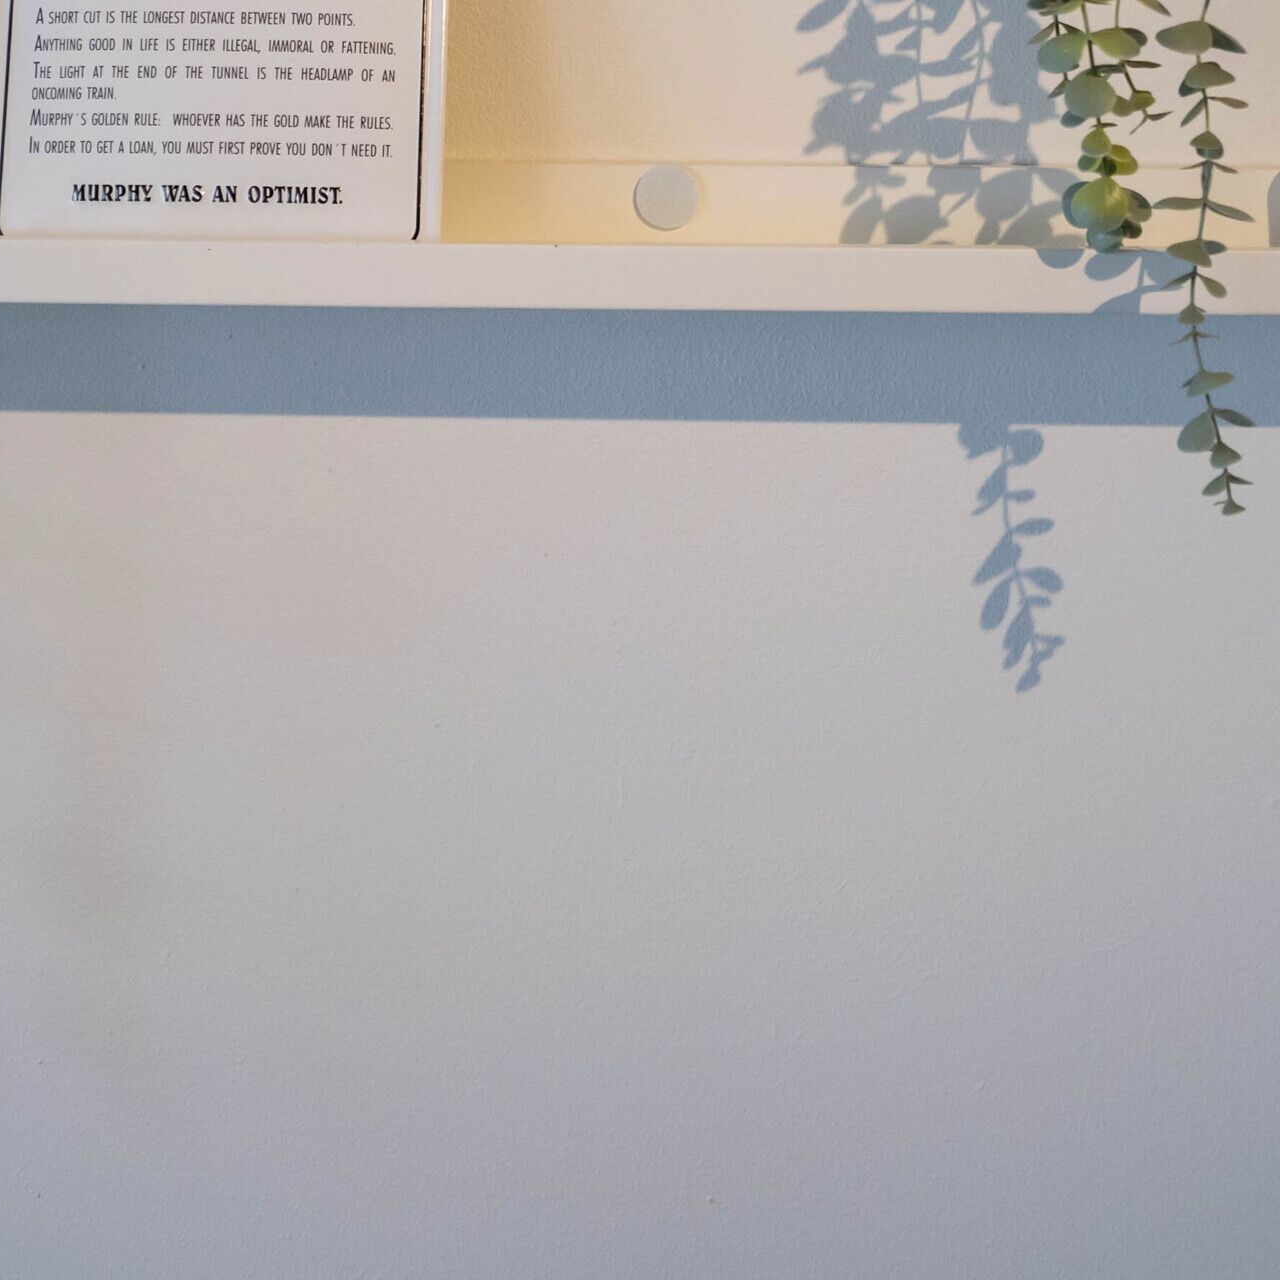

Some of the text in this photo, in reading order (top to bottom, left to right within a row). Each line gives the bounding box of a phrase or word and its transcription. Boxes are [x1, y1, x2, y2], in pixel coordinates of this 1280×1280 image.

[35, 7, 356, 27] A SHORT CUT IS THE LONGEST DISTANCE BETWEEN TWO POINTS.
[34, 34, 396, 56] ANYTHING GOOD IN LIFE IS EITHER ILLEGAL, IMMORAL OR FATTENING.
[32, 61, 396, 83] THE LIGHT AT THE END OF THE TUNNEL IS THE HEADLAMP OF AN
[31, 86, 117, 101] ONCOMING TRAIN.
[29, 135, 40, 154] IN
[44, 140, 76, 154] ORDER
[80, 140, 93, 154] TO
[96, 140, 115, 154] GET
[117, 140, 125, 154] A
[129, 140, 157, 156] LOAN,
[161, 140, 182, 155] YOU
[185, 140, 215, 155] MUST
[218, 141, 246, 155] FIRST
[249, 141, 282, 156] PROVE
[285, 142, 306, 156] YOU
[351, 143, 377, 158] NEED
[381, 144, 393, 158] IT.
[73, 184, 343, 205] MURPHY WAS AN OPTIMIST.
